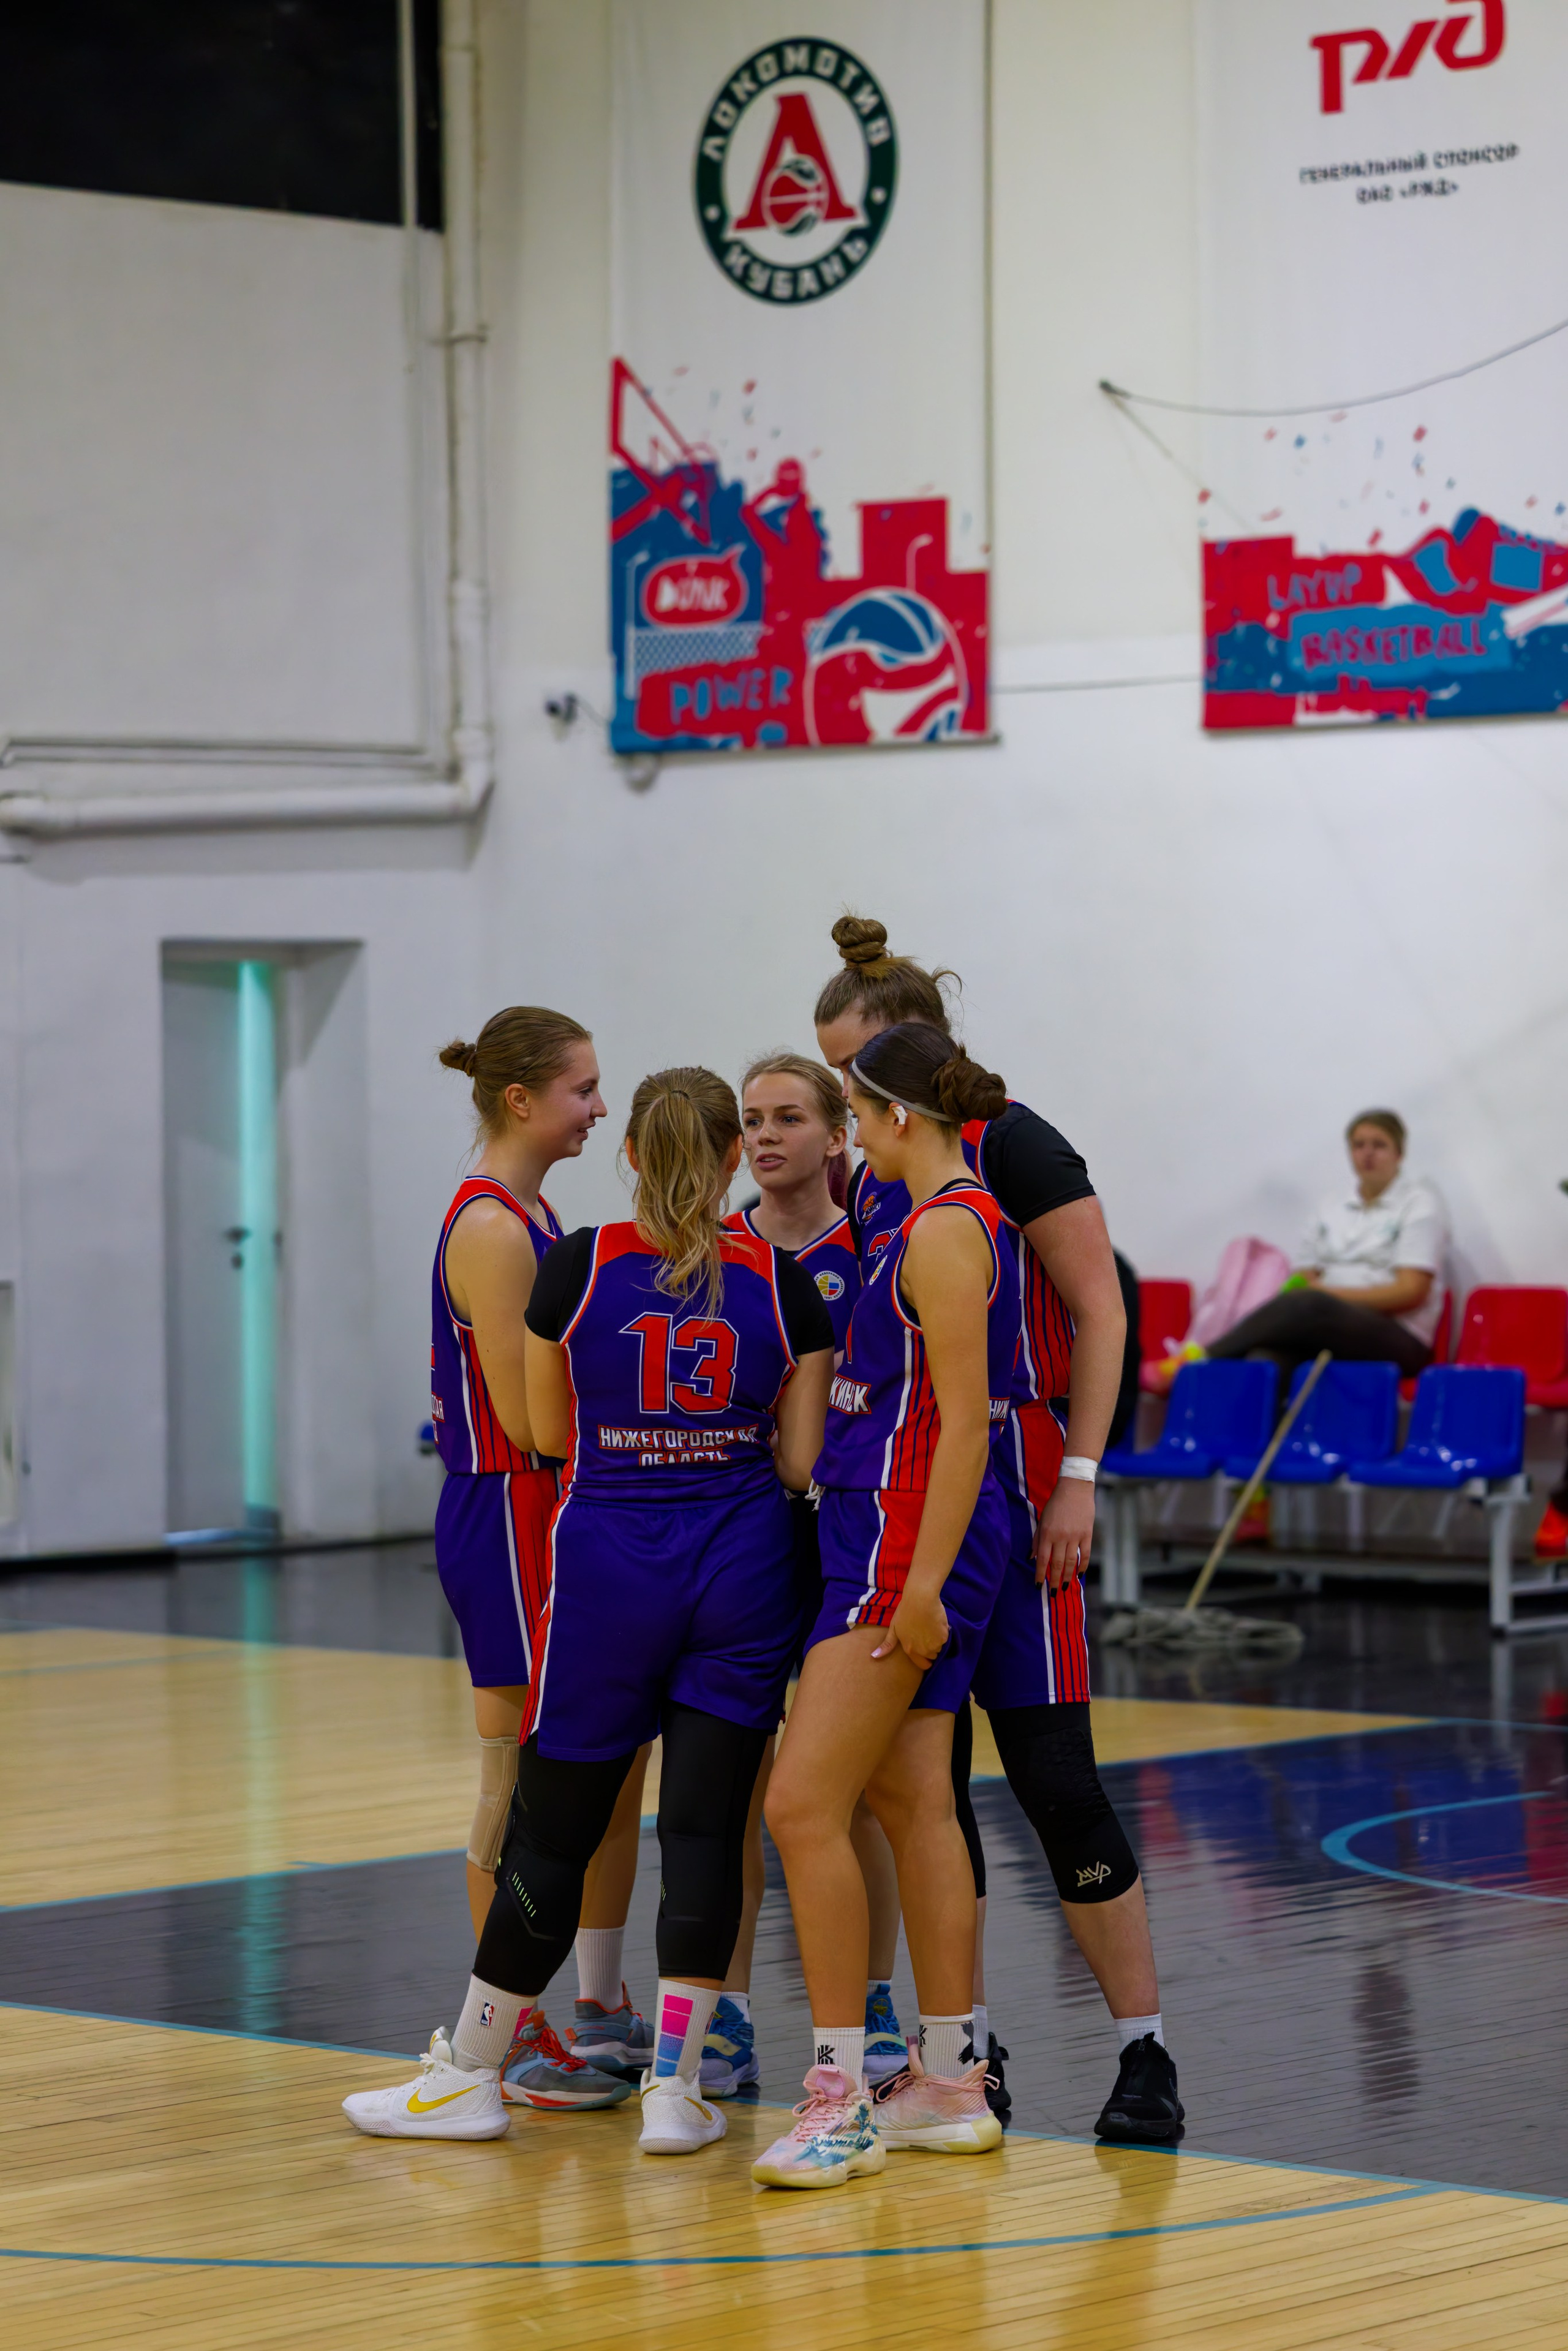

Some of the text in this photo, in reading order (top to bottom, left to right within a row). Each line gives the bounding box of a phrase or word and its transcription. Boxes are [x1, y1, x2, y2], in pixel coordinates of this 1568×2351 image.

[703, 43, 891, 162] ЛОКОМОТИВ
[724, 238, 868, 299] КУБАНЬ
[1300, 617, 1488, 672] BASKETBALL
[669, 665, 794, 725] POWER
[618, 1311, 739, 1414] 13
